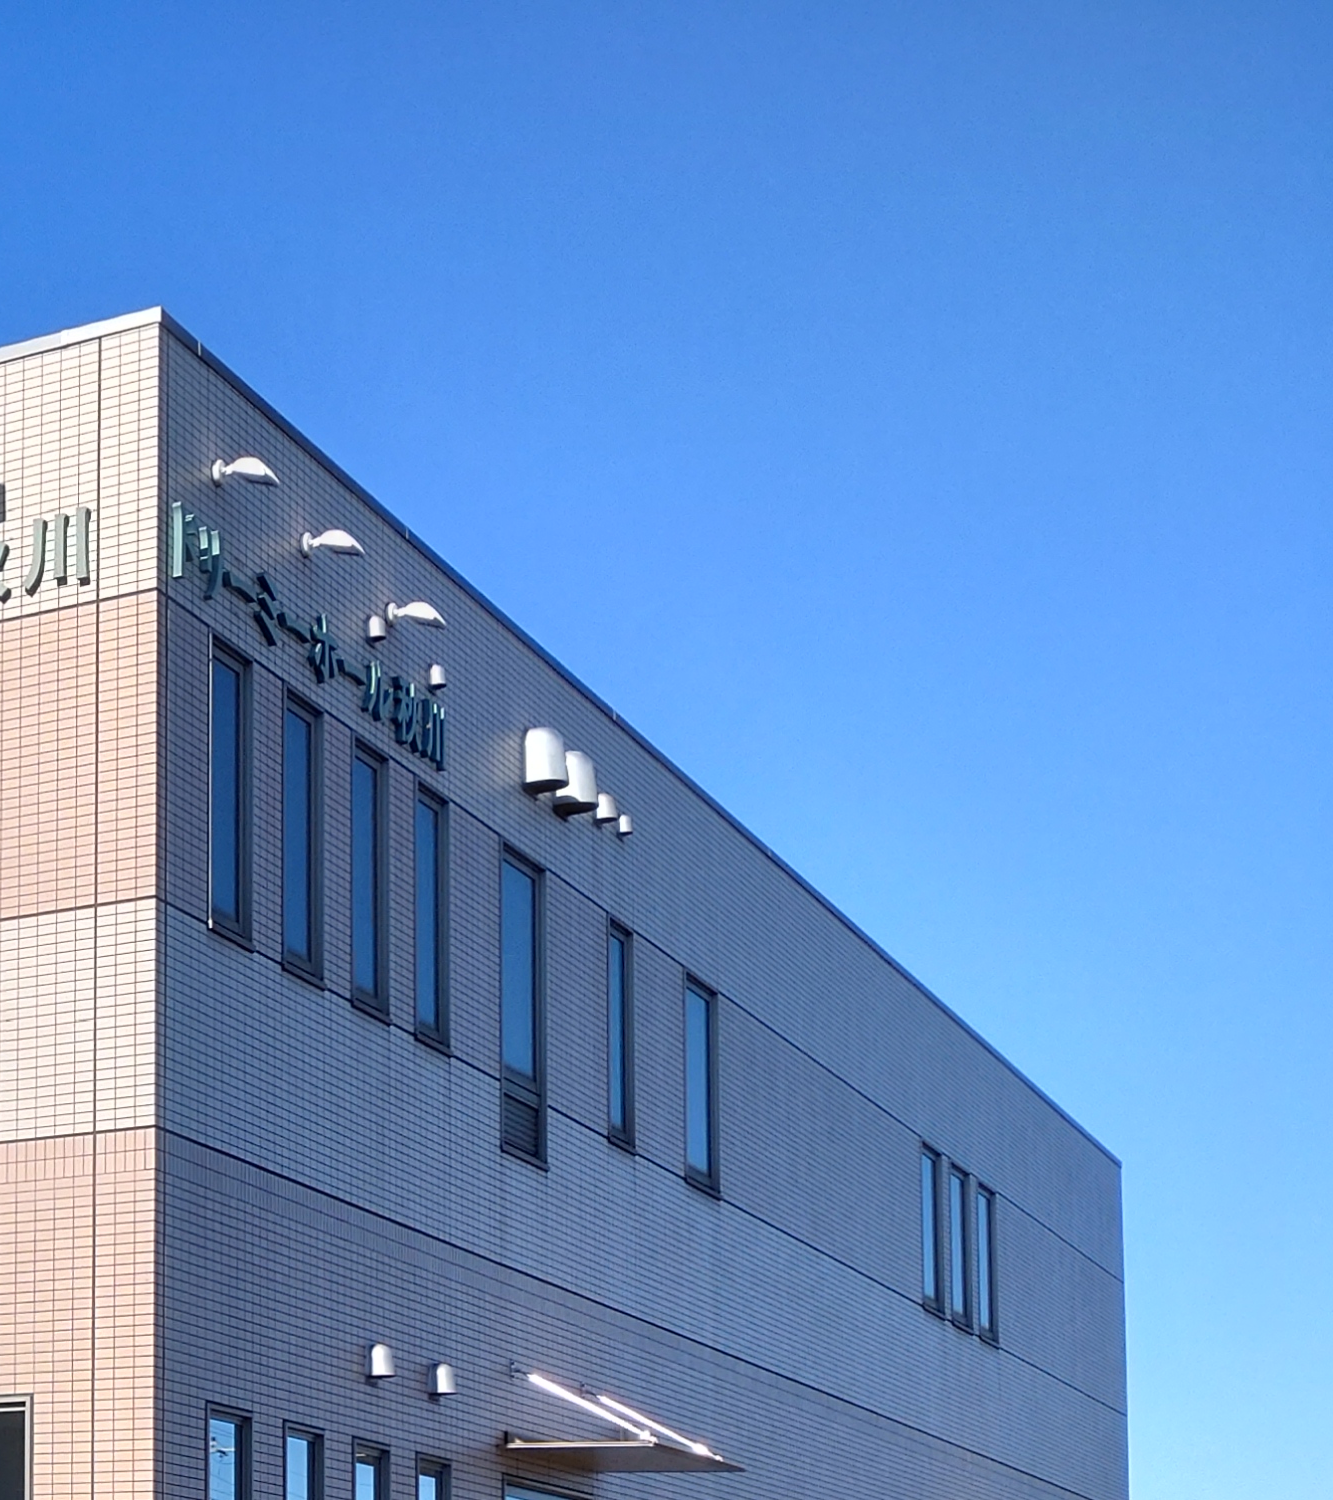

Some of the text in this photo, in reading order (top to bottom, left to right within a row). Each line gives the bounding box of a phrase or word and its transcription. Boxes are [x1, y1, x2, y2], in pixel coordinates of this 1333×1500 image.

[171, 501, 445, 771] ドリーミーホール秋川
